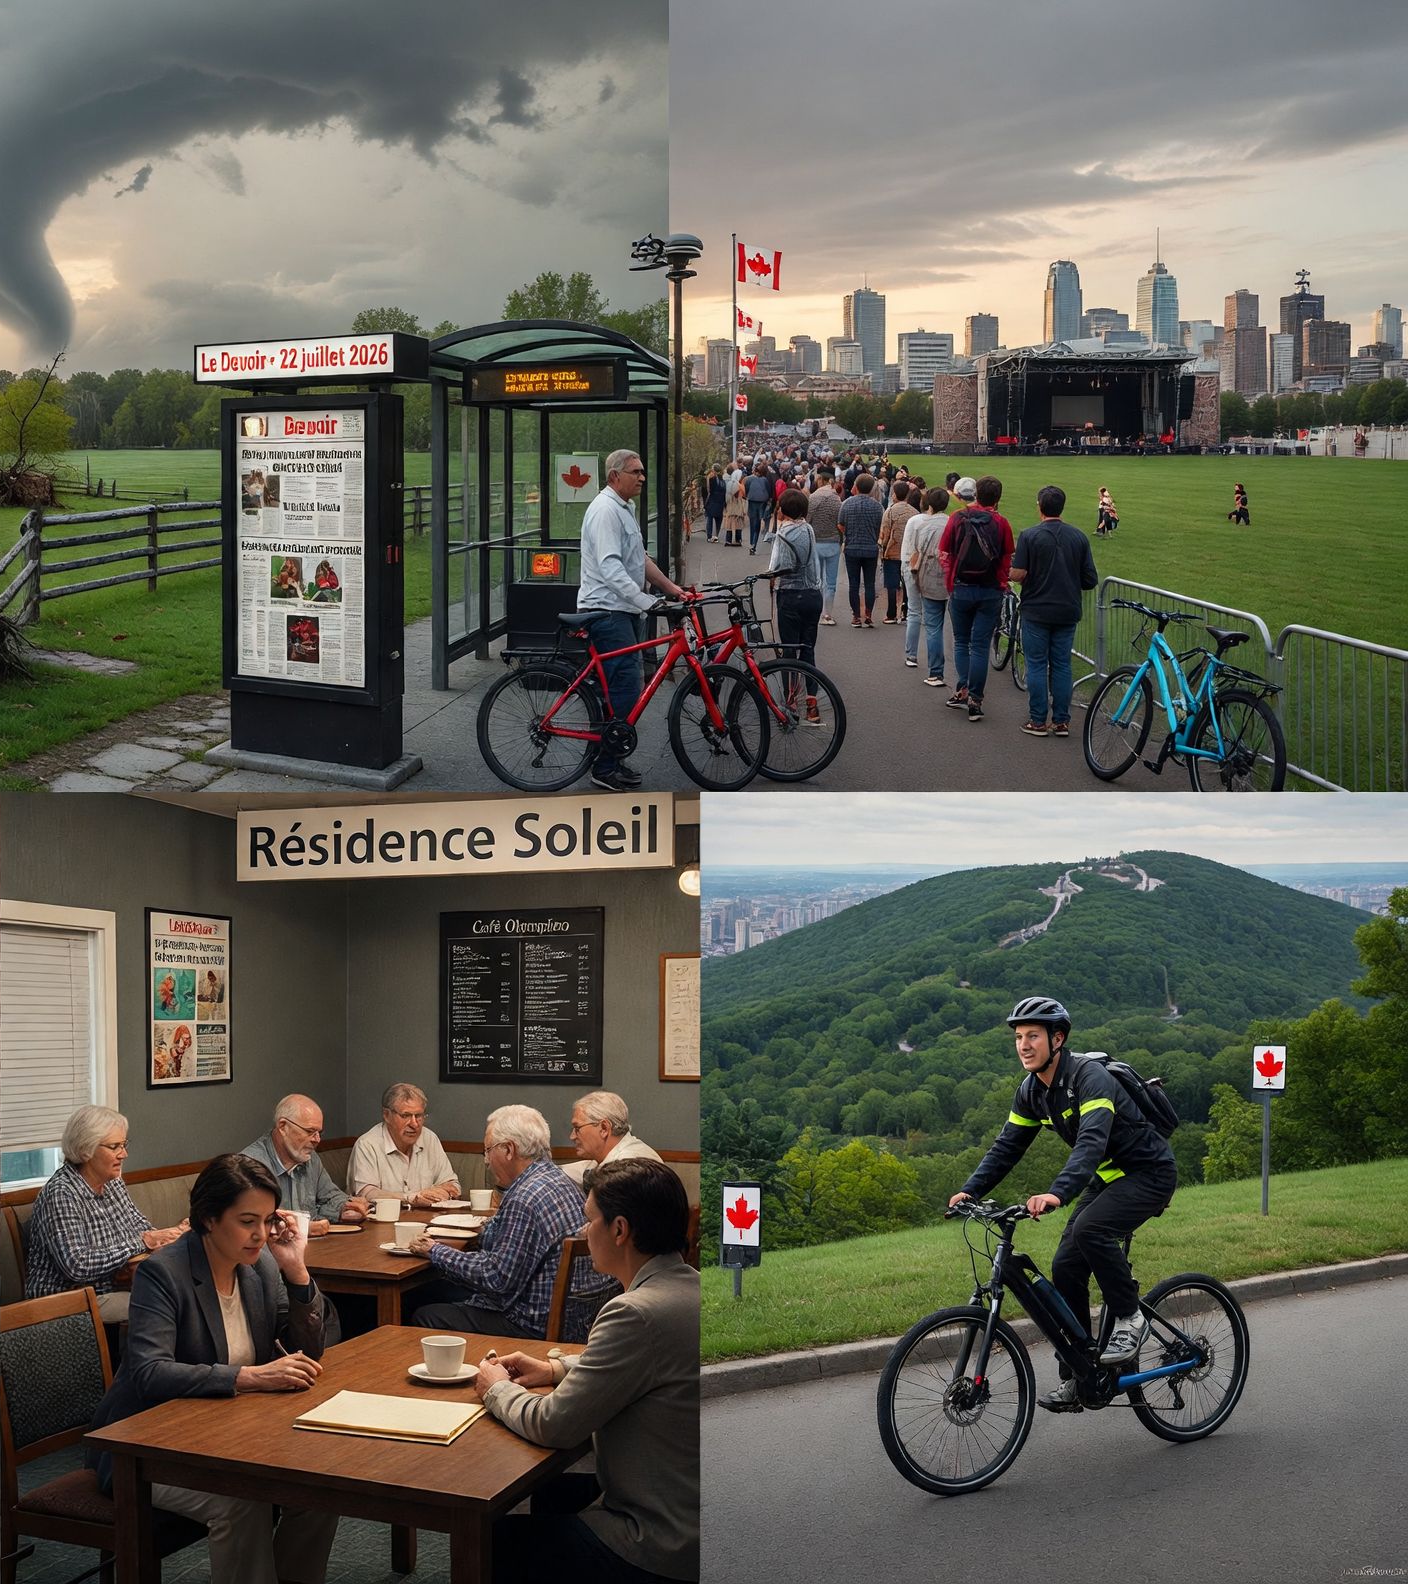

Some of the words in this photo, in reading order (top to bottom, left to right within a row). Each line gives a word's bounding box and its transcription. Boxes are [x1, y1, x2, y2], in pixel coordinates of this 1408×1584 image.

[201, 352, 217, 372] Le
[221, 350, 267, 372] Devoir
[280, 348, 298, 369] 22
[300, 345, 345, 372] juillet
[349, 342, 388, 366] 2026
[249, 818, 495, 868] Résidence
[513, 805, 658, 858] Soleil
